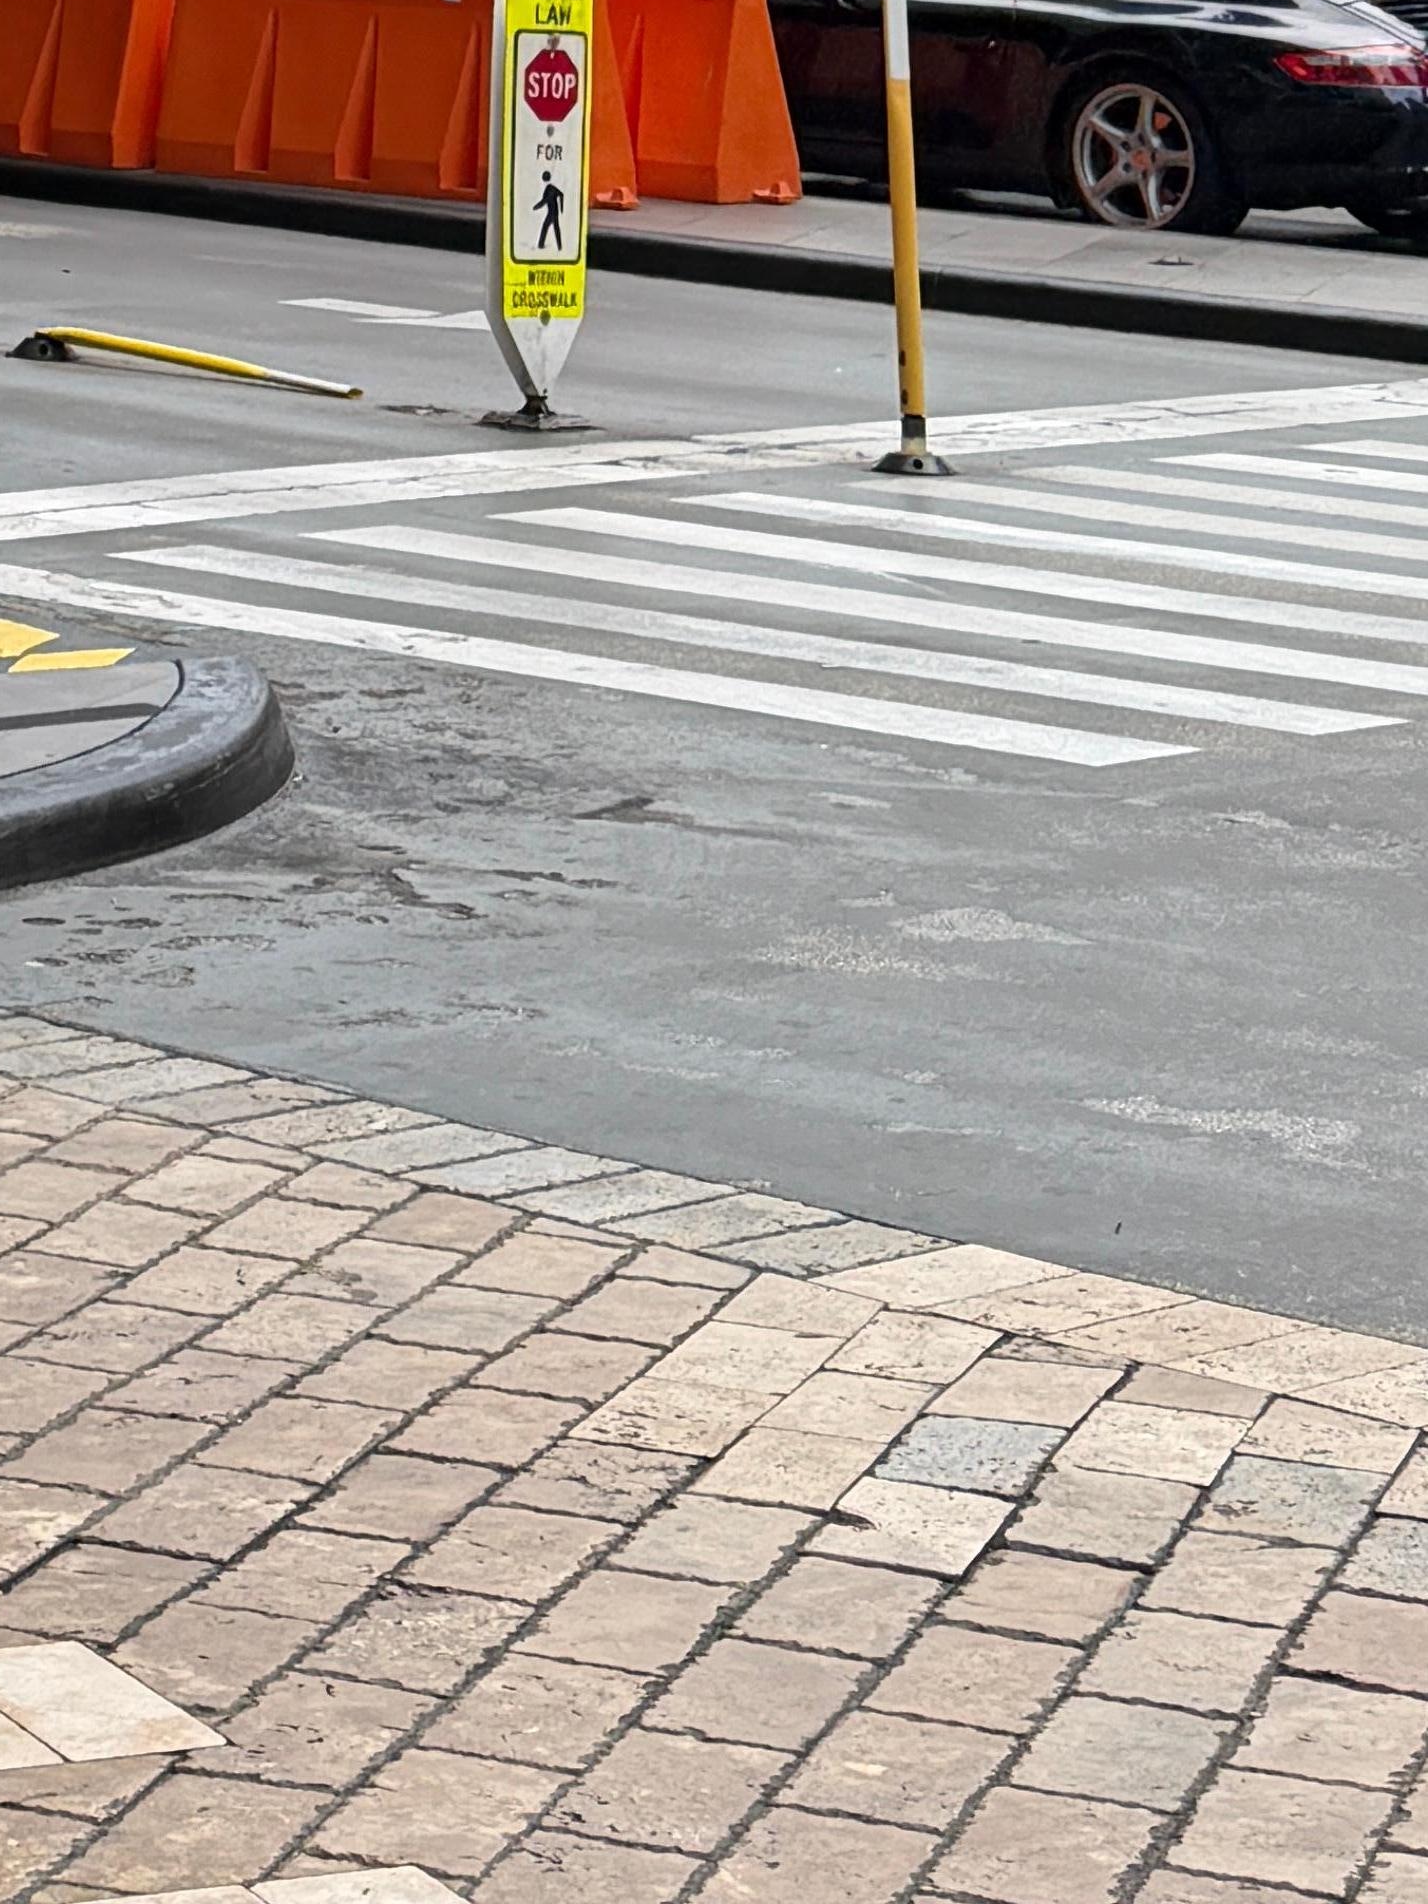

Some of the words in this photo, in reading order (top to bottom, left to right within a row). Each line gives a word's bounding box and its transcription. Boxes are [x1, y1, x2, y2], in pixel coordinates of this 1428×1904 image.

[535, 3, 571, 26] LAW
[528, 72, 576, 99] STOP
[536, 144, 563, 160] FOR
[512, 290, 577, 308] CROSSWALK
